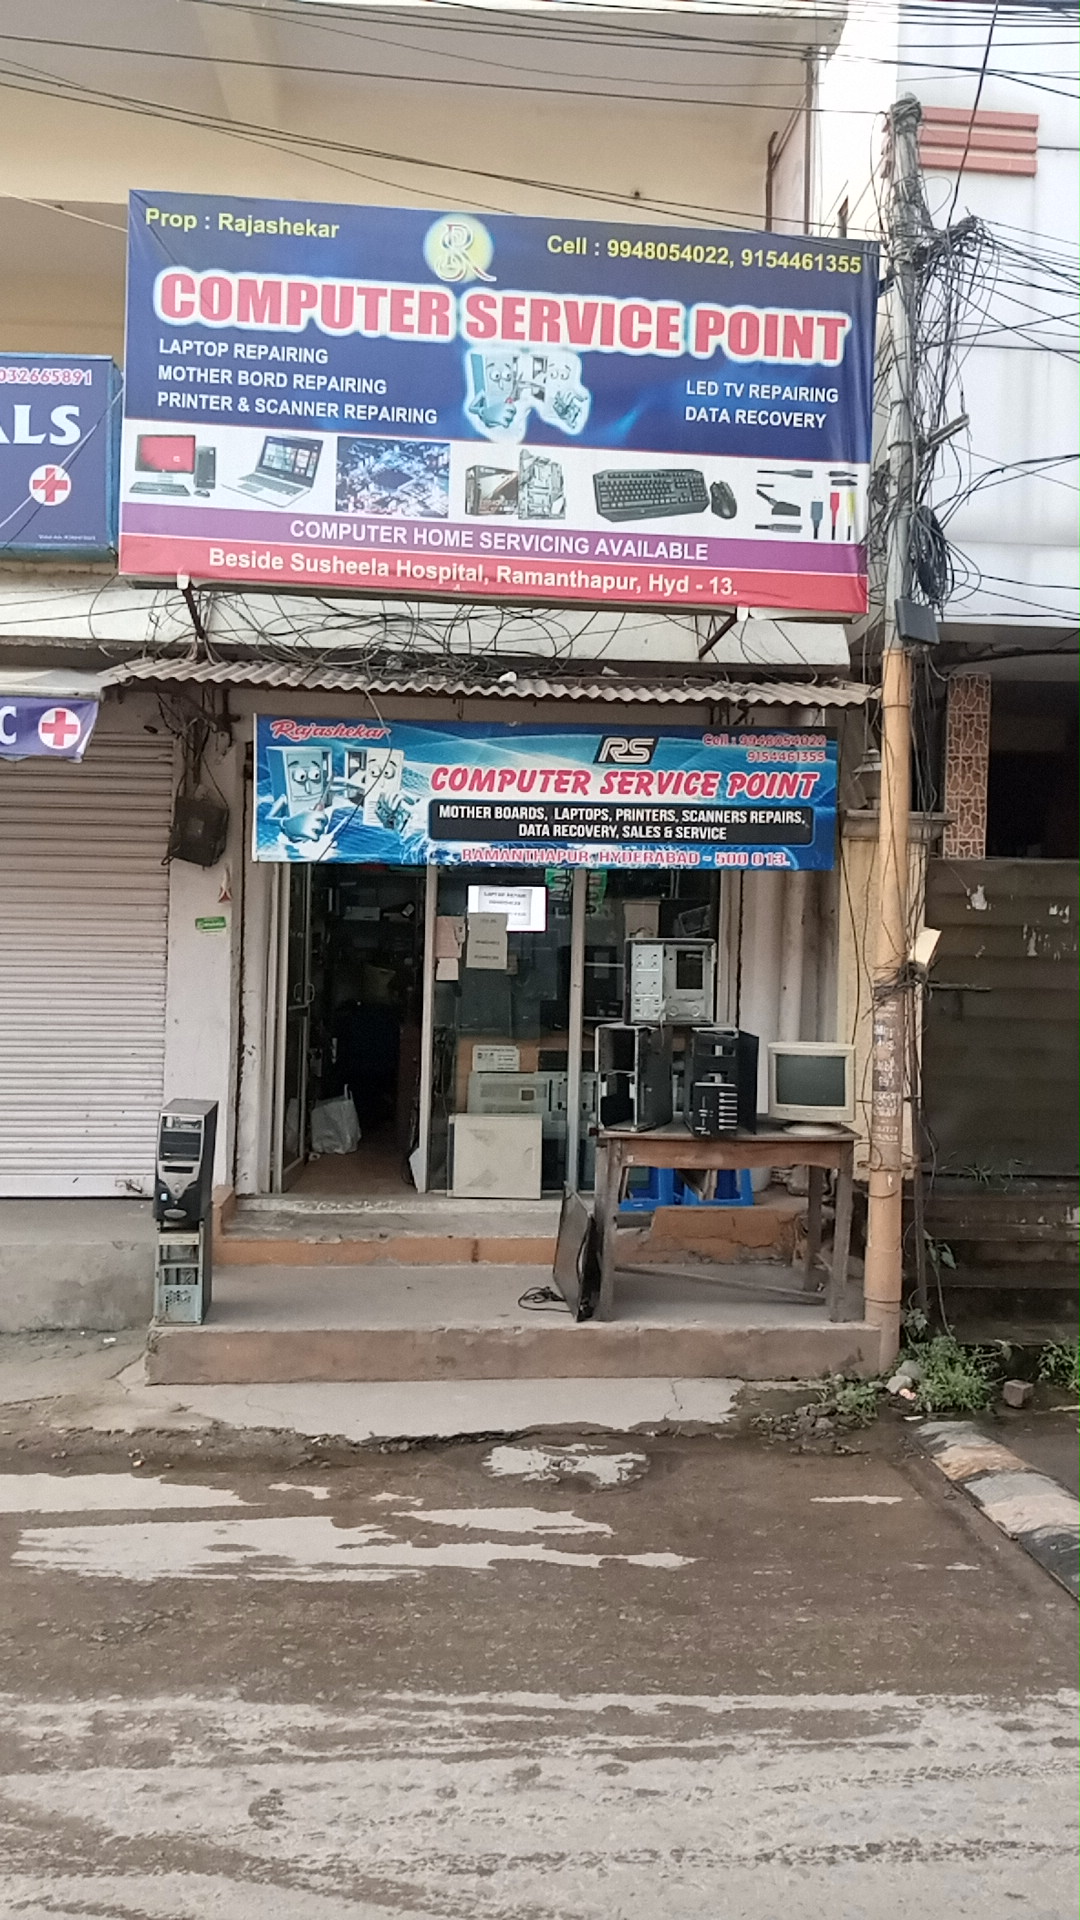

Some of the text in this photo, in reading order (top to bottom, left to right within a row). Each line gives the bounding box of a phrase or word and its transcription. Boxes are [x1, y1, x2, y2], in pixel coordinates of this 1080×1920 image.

[145, 208, 198, 231] Prop
[218, 213, 339, 238] Rajashekar
[547, 235, 587, 256] Cell
[607, 239, 734, 269] 9948054022,
[741, 250, 862, 274] 9154461355
[159, 272, 847, 362] COMPUTER SERVICE POINT
[159, 338, 329, 364] LAPTOP REPAIRING
[158, 365, 387, 395] MOTHER BORD REPAIRING
[686, 380, 839, 403] LED TV REPAIRING
[157, 392, 438, 425] PRINTER & SCANNER REPAIRING
[685, 406, 827, 429] DATA RECOVERY
[289, 520, 709, 561] COMPUTER HOME SERVICING AVAILABLE
[209, 548, 284, 570] Beside
[290, 553, 389, 576] Susheela
[396, 559, 490, 586] Hospital,
[496, 566, 641, 594] Ramanthapur,
[648, 574, 689, 596] Hyd
[709, 578, 738, 596] 13.
[270, 720, 392, 741] Rajashekar
[598, 737, 655, 764] RS
[747, 750, 827, 763] 9154461355
[431, 766, 819, 799] COMPUTER SERVICE POINT
[438, 804, 492, 819] MOTHER
[494, 805, 548, 821] BOARDS,
[554, 807, 613, 822] LAPTOPS,
[615, 808, 679, 824] PRINTERS,
[682, 809, 748, 824] SCANNERS
[518, 824, 727, 841] DATA RECOVERY, SALES & SERVICE
[599, 849, 700, 865] HYDERABAD
[715, 851, 748, 866] 500
